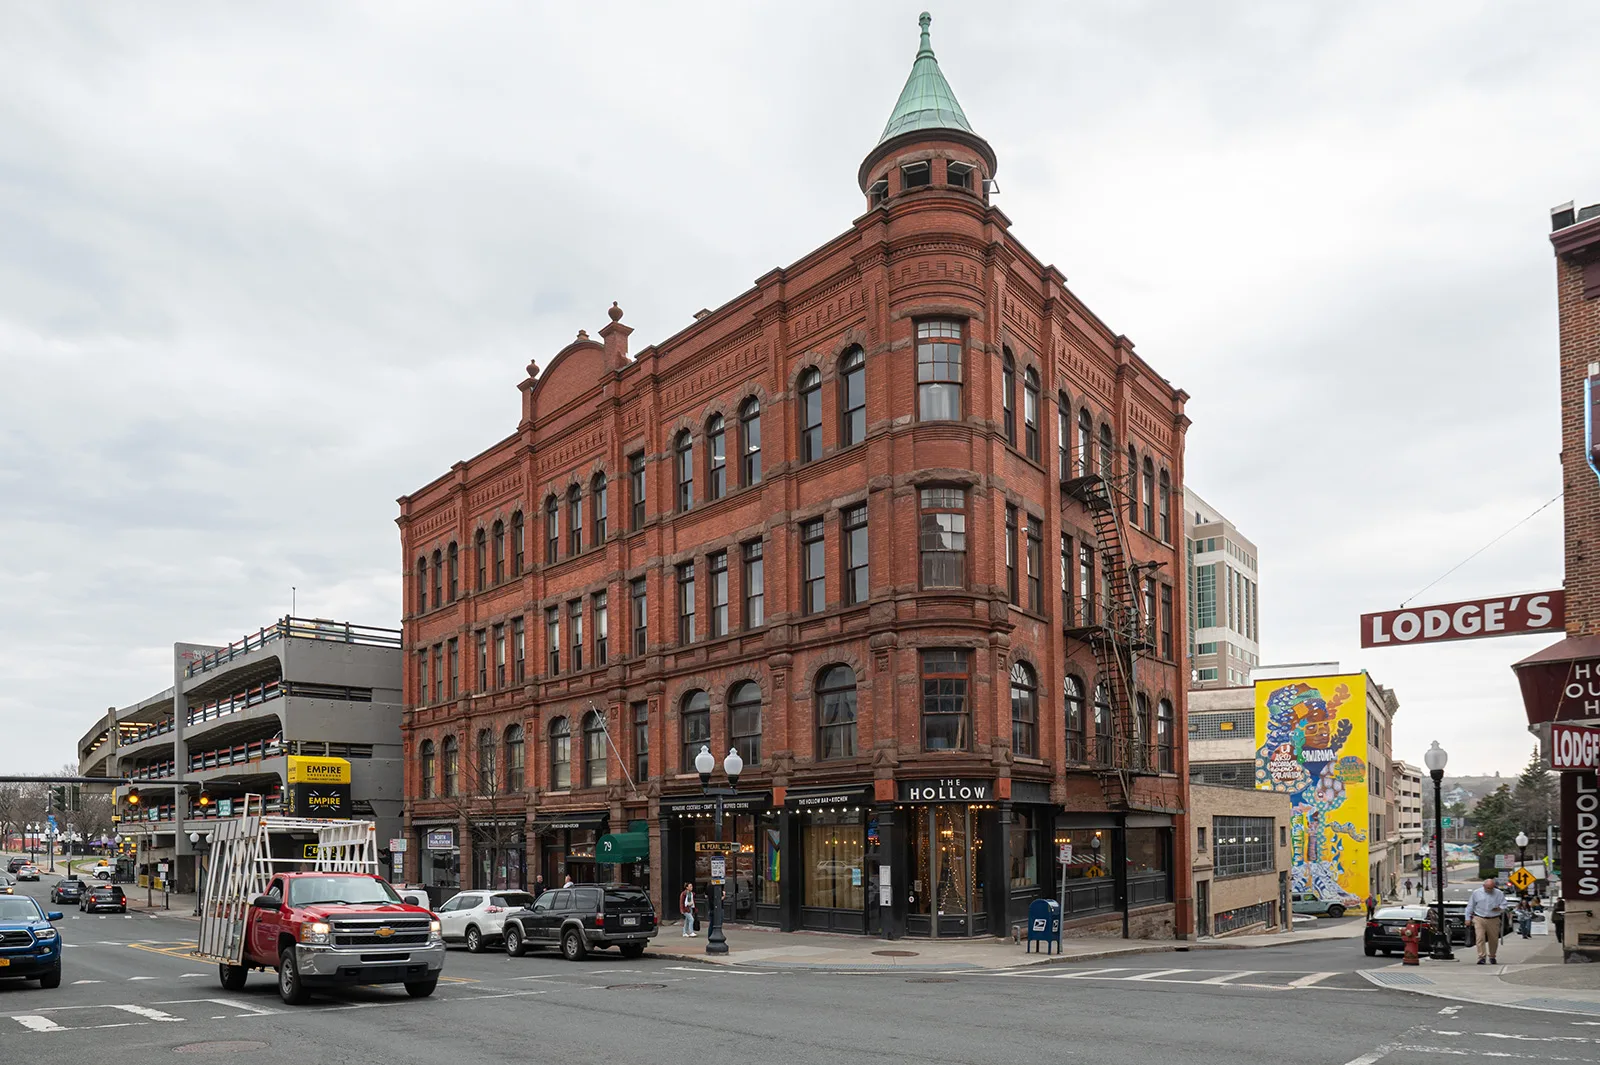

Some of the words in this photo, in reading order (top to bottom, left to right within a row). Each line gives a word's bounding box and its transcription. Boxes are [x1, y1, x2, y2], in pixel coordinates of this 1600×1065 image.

[1372, 595, 1553, 644] LODGE'S
[307, 765, 341, 774] EMPIRE
[910, 786, 985, 800] HOLLOW
[308, 797, 340, 805] EMPIRE
[603, 841, 612, 852] 79
